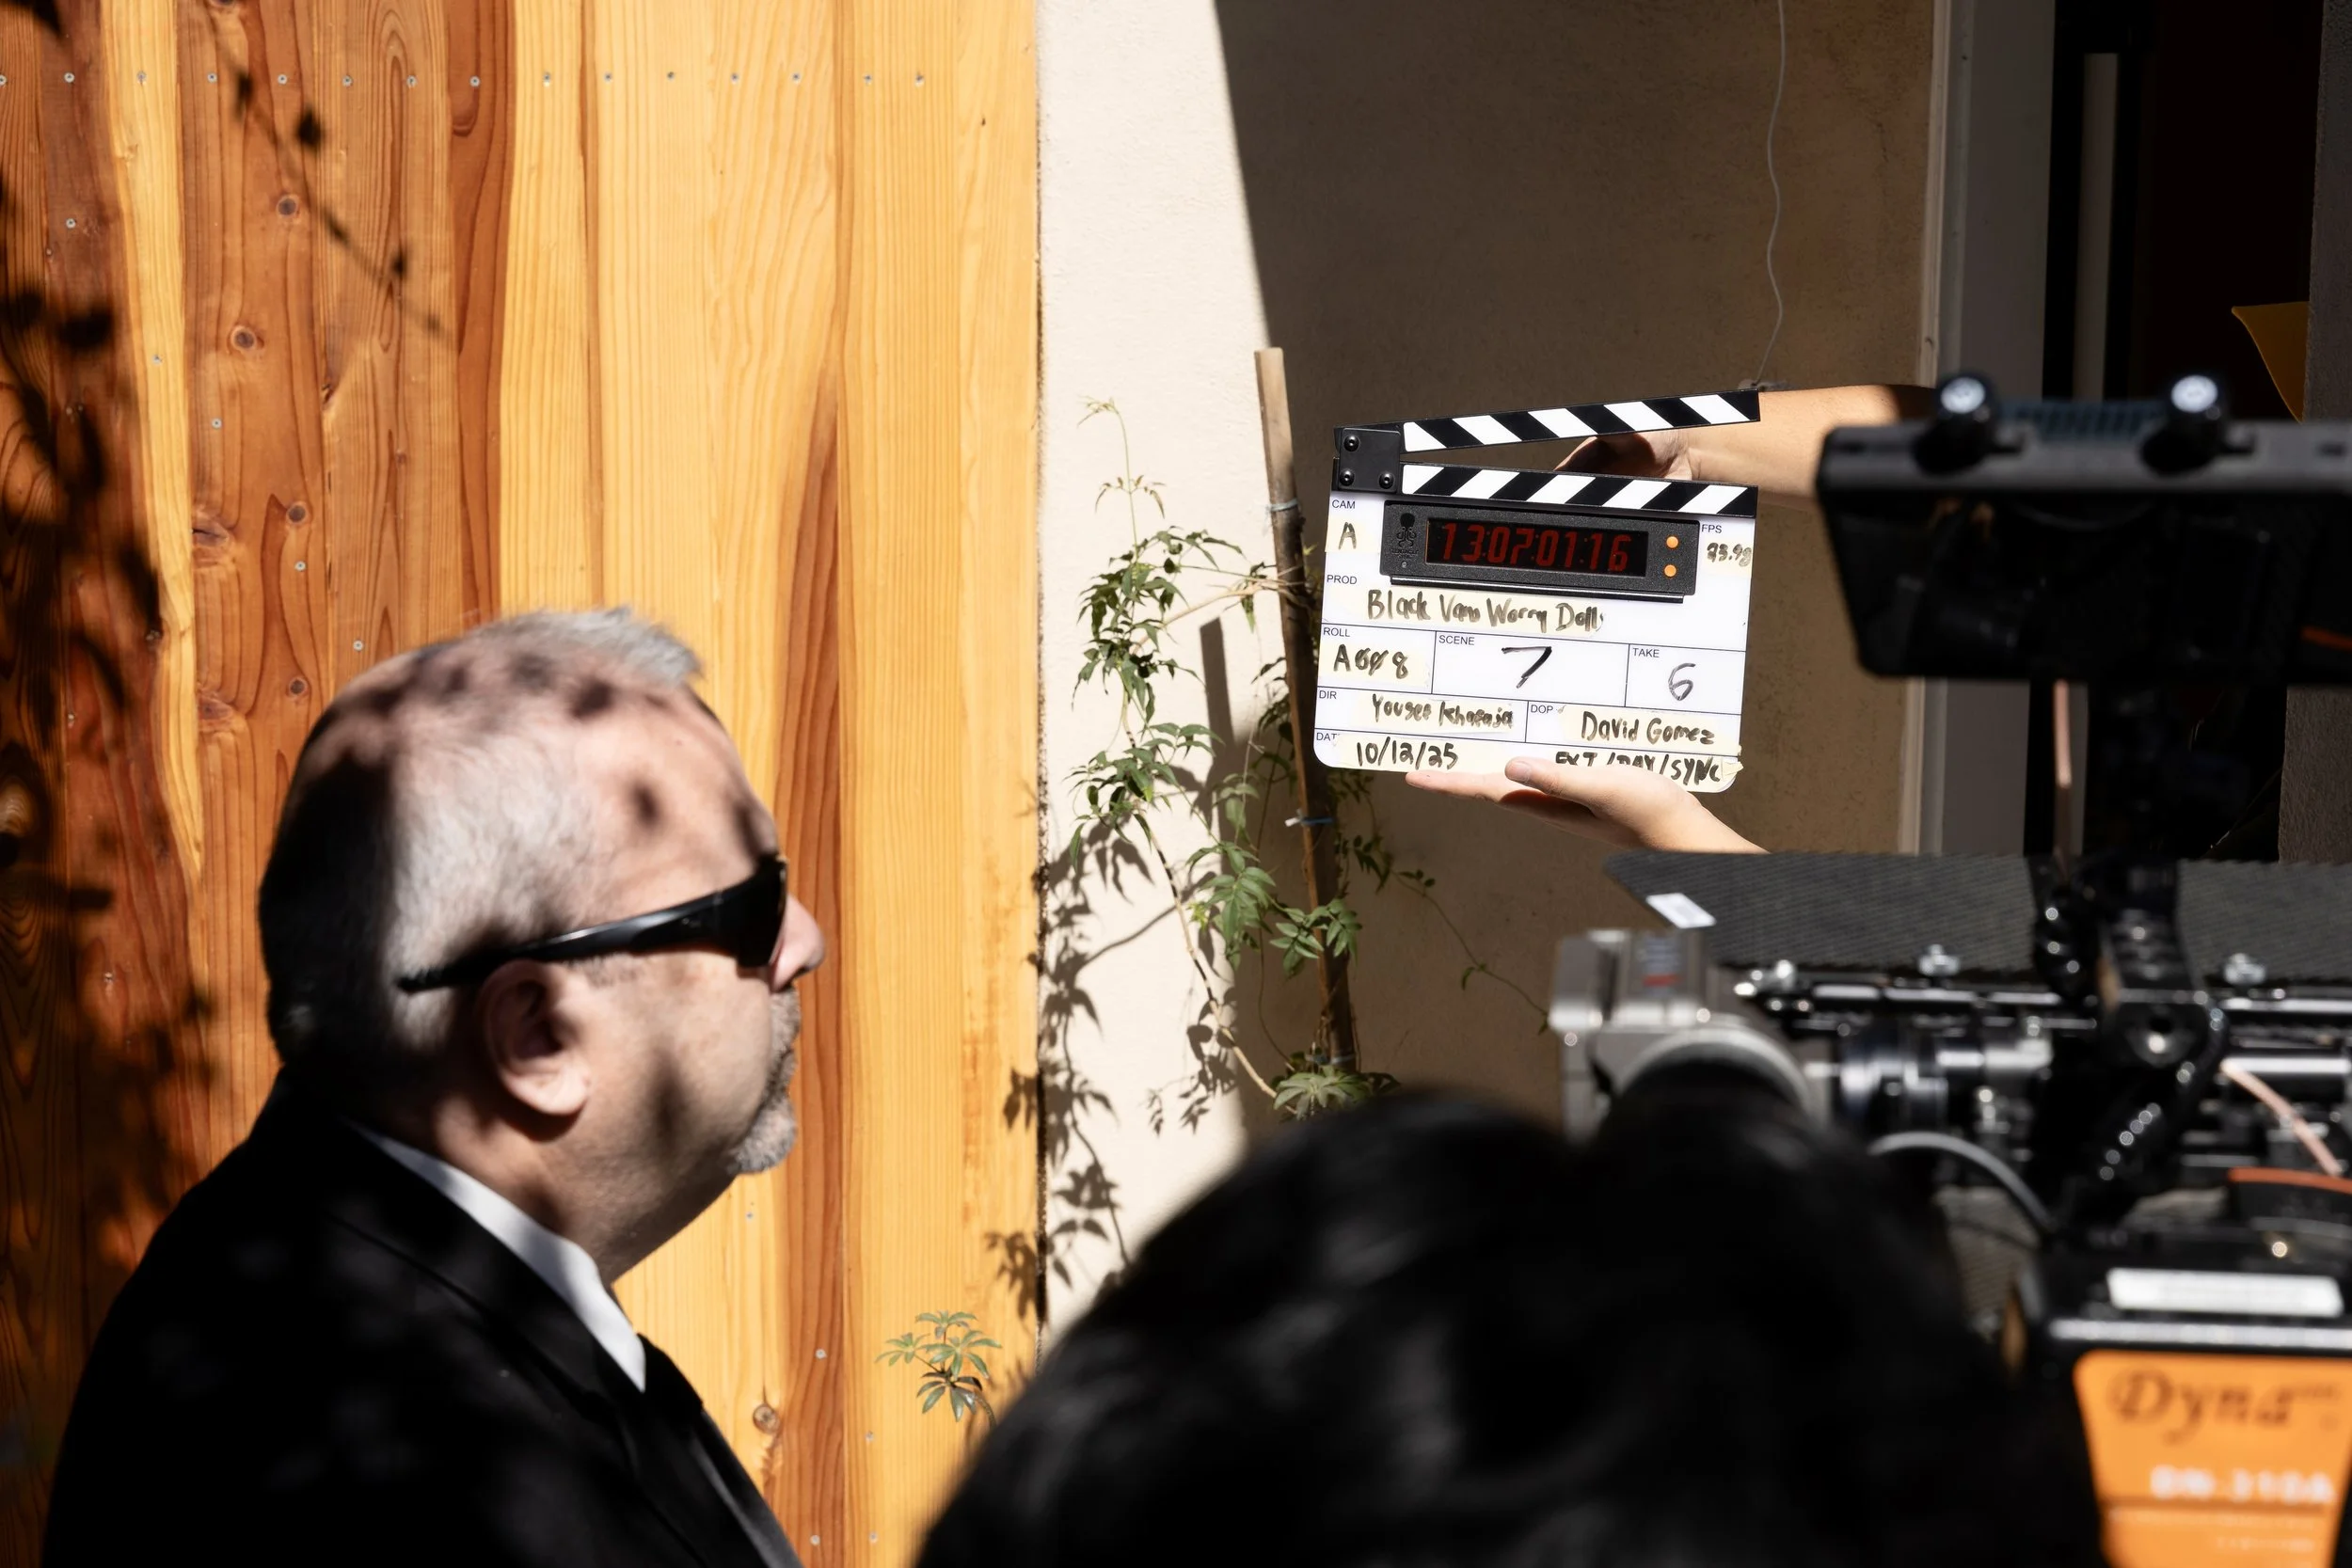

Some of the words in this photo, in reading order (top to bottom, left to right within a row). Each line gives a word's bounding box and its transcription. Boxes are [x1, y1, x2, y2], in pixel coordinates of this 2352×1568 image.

[1331, 499, 1356, 510] CAM
[1701, 523, 1723, 534] FPS
[1338, 521, 1358, 550] A
[1327, 574, 1358, 585] PROD
[1367, 589, 1431, 621] Black
[1486, 597, 1548, 634] Worry
[1323, 626, 1351, 638] ROLL
[1438, 634, 1475, 646] SCENE
[1632, 647, 1661, 658] TAKE
[1501, 645, 1553, 689] 7
[1668, 662, 1696, 702] 6
[1319, 690, 1337, 700] DIR
[1531, 705, 1553, 714] DOP
[1581, 710, 1640, 741] David
[1647, 717, 1715, 745] Gomez
[1316, 732, 1341, 741] DAT
[1357, 736, 1459, 770] 10/12/25
